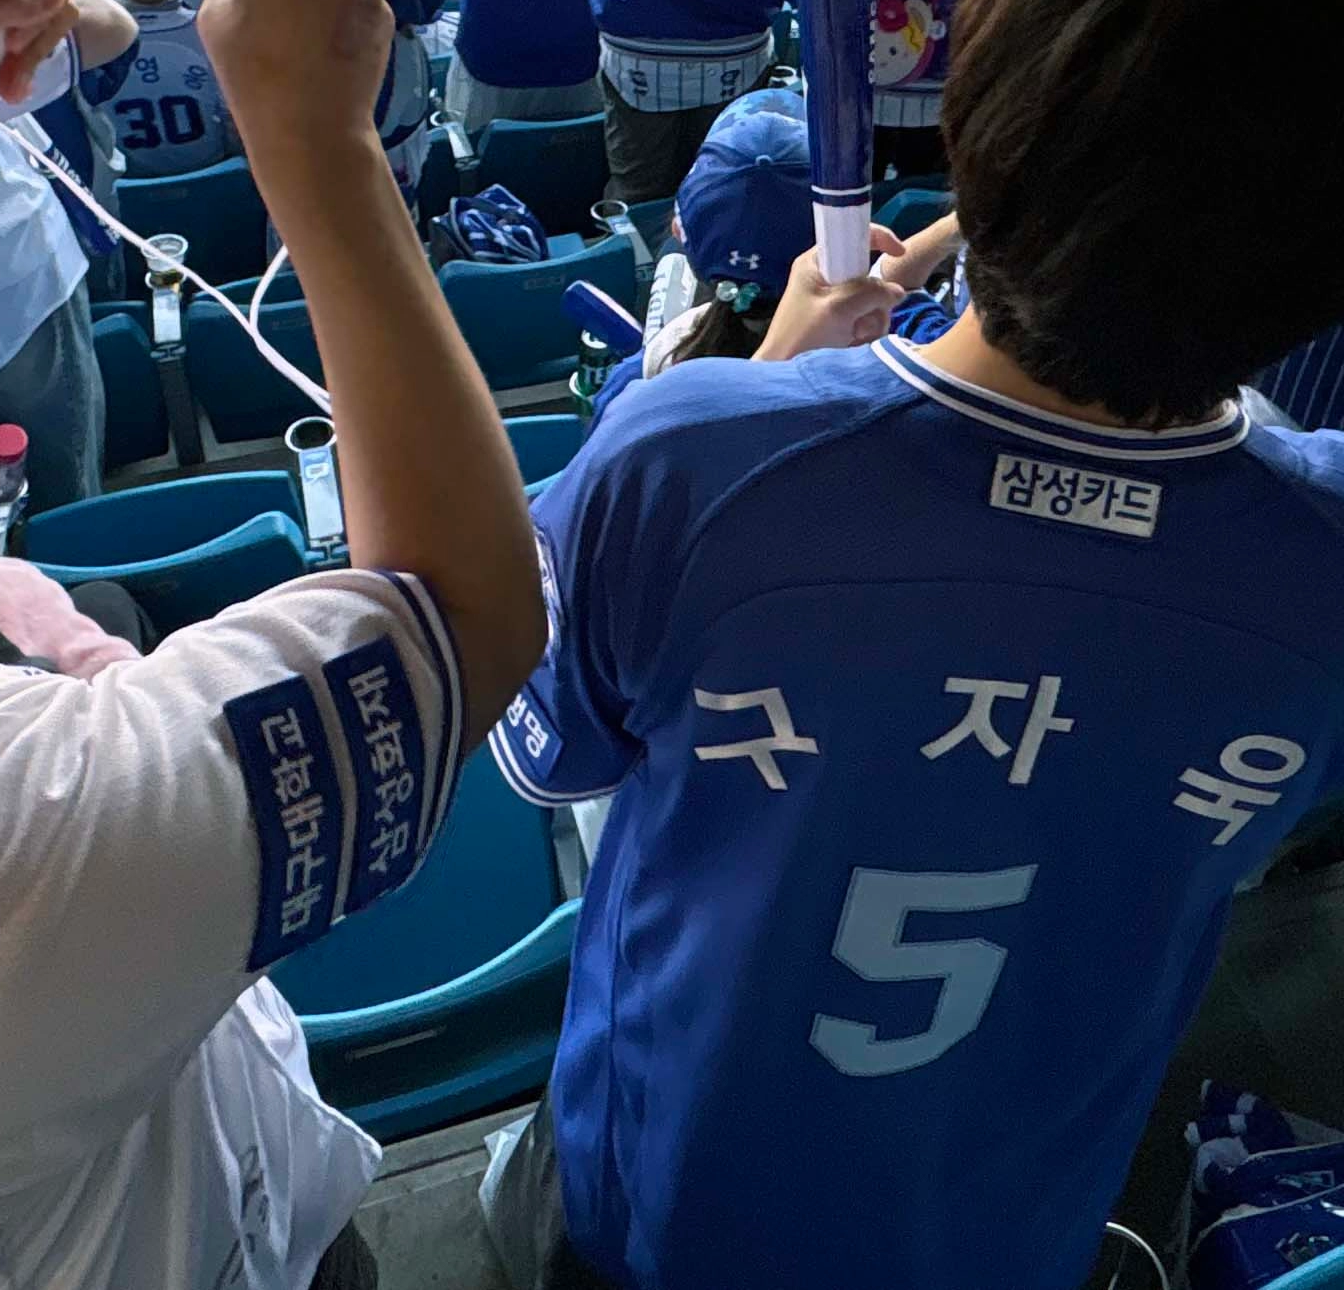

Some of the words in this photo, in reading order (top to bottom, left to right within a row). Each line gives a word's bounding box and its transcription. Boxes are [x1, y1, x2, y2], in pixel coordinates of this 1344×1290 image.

[114, 95, 205, 149] 30
[1001, 457, 1159, 527] 삼성카드
[262, 711, 333, 938] 대구대학교
[344, 668, 414, 878] 삼성화재
[693, 673, 1308, 847] 구자욱
[808, 862, 1040, 1079] 5
